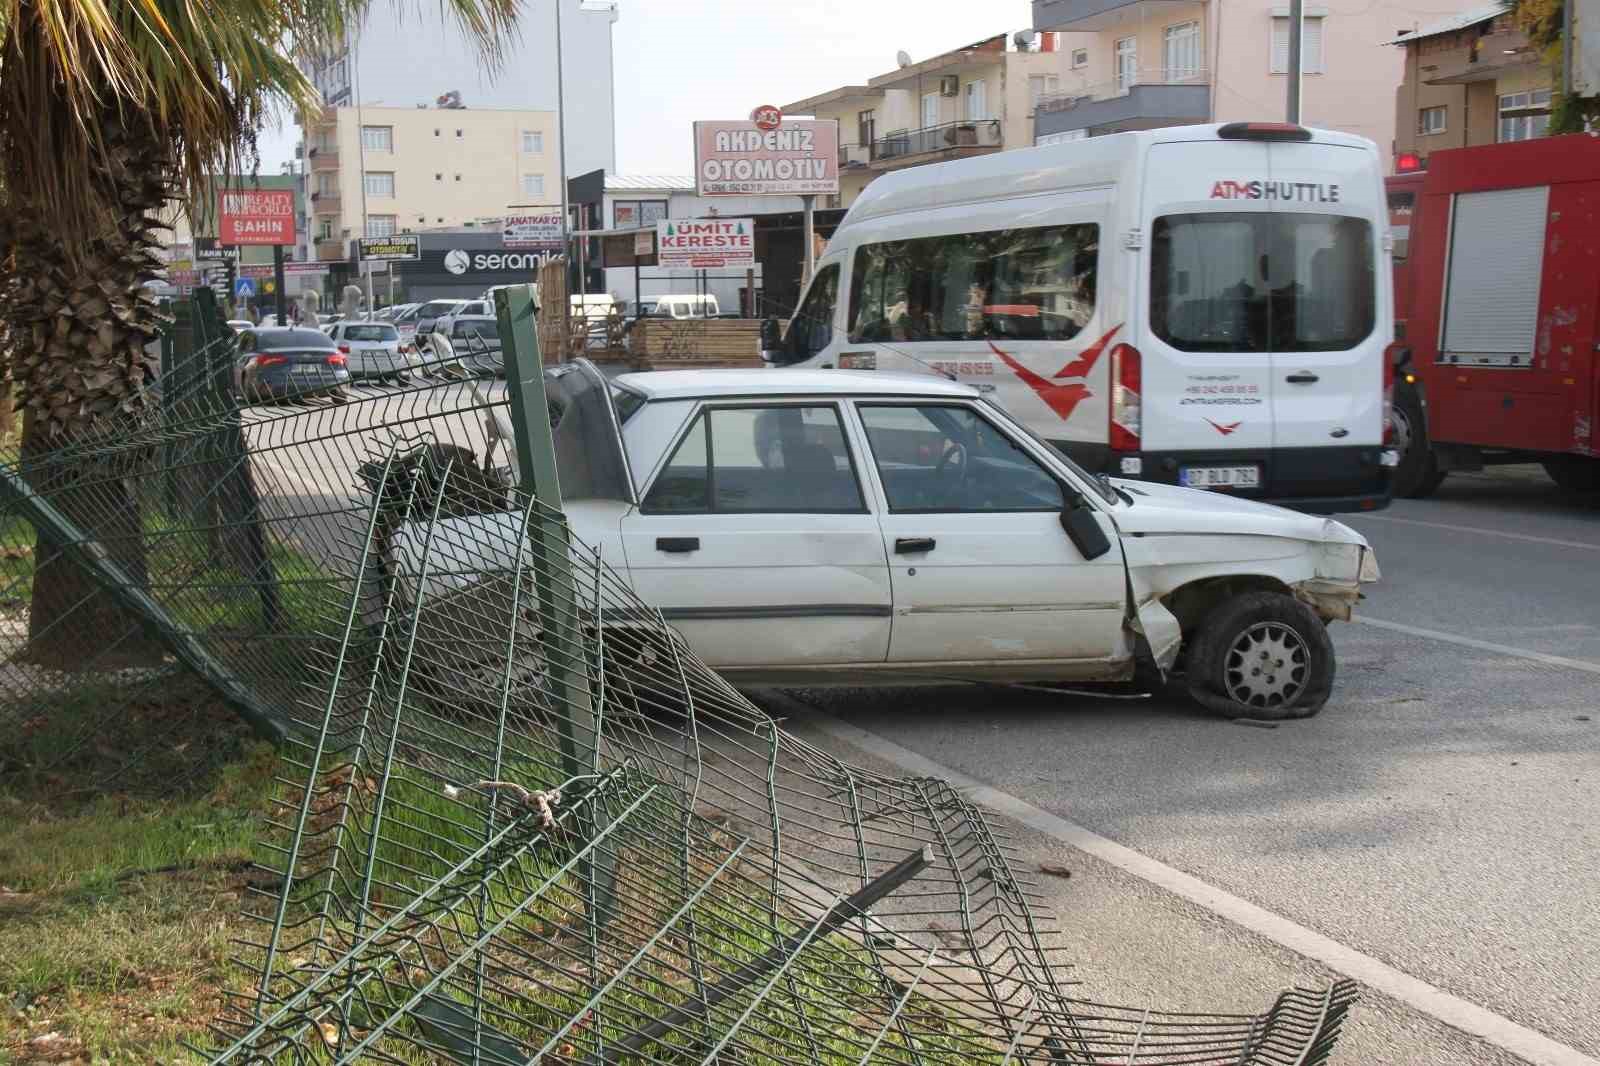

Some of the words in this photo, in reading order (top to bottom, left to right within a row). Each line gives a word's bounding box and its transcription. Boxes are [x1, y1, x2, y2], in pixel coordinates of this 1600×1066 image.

[716, 124, 814, 151] AKDENİZ
[704, 153, 827, 180] OTOMOTİV
[677, 220, 734, 235] ÜMİT
[661, 235, 750, 248] KERESTE
